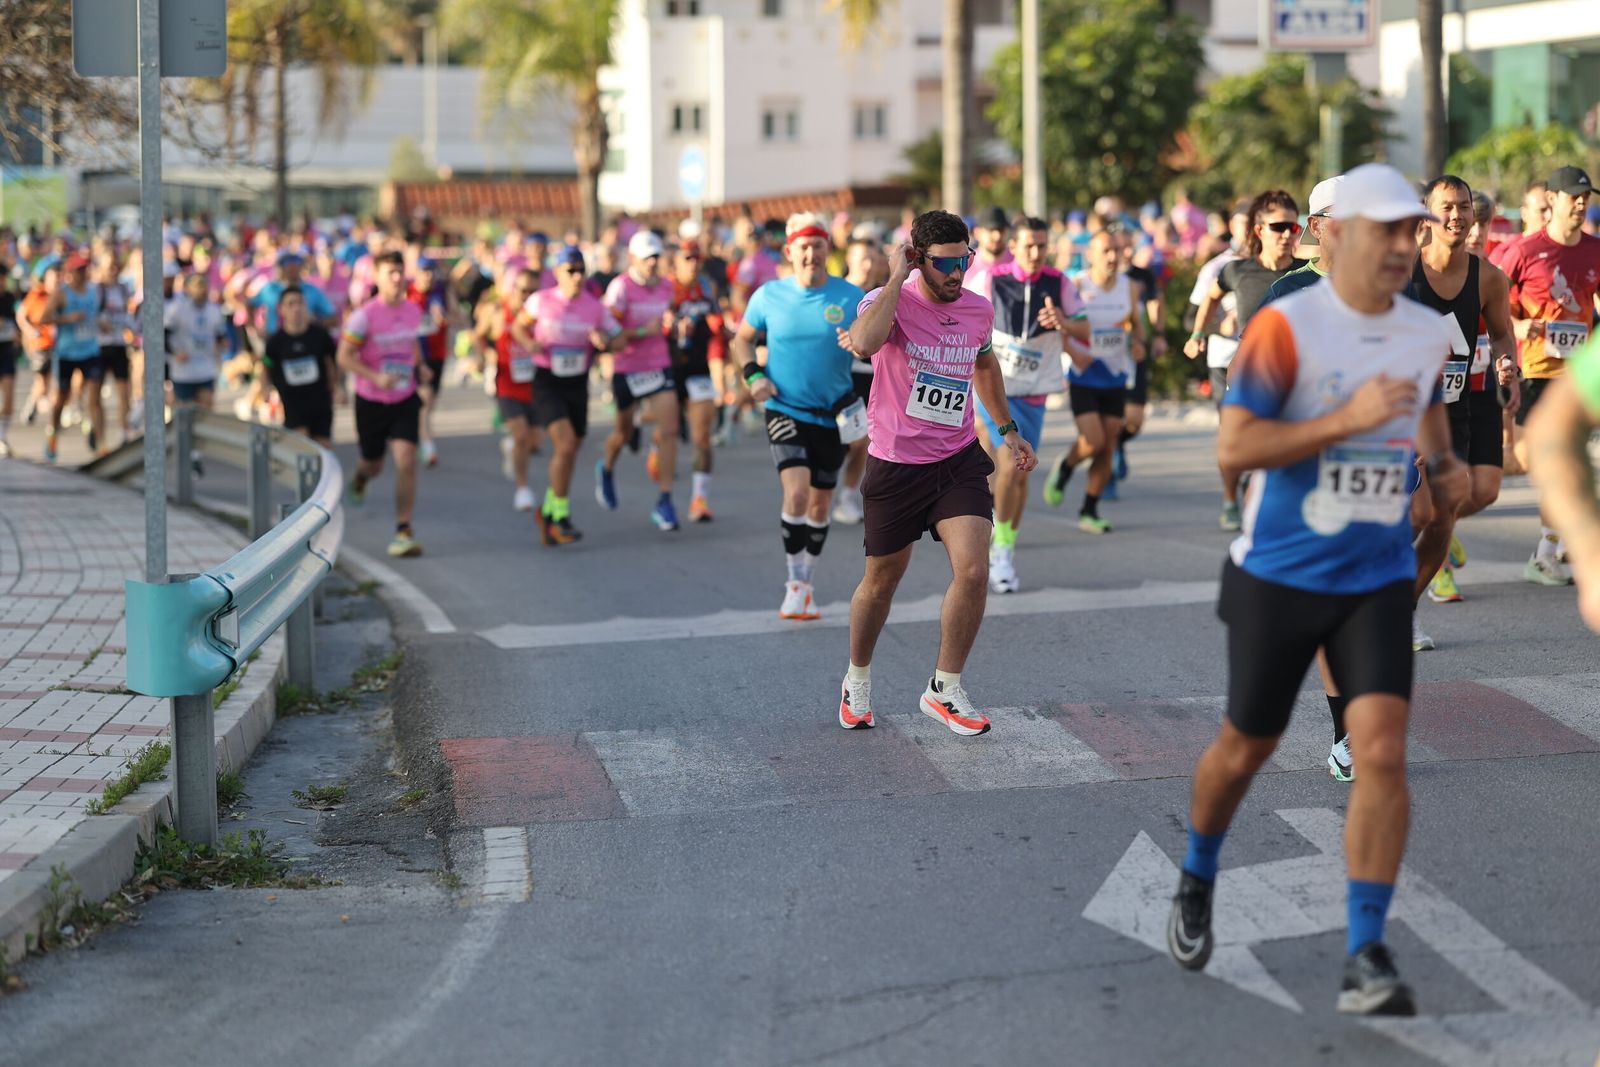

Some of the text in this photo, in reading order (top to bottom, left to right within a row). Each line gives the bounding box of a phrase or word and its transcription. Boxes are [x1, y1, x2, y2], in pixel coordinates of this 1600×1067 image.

[938, 333, 967, 345] XXXVI
[905, 341, 940, 362] MEDIA
[908, 358, 968, 376] INTERNACIONAL
[917, 385, 964, 411] 1012
